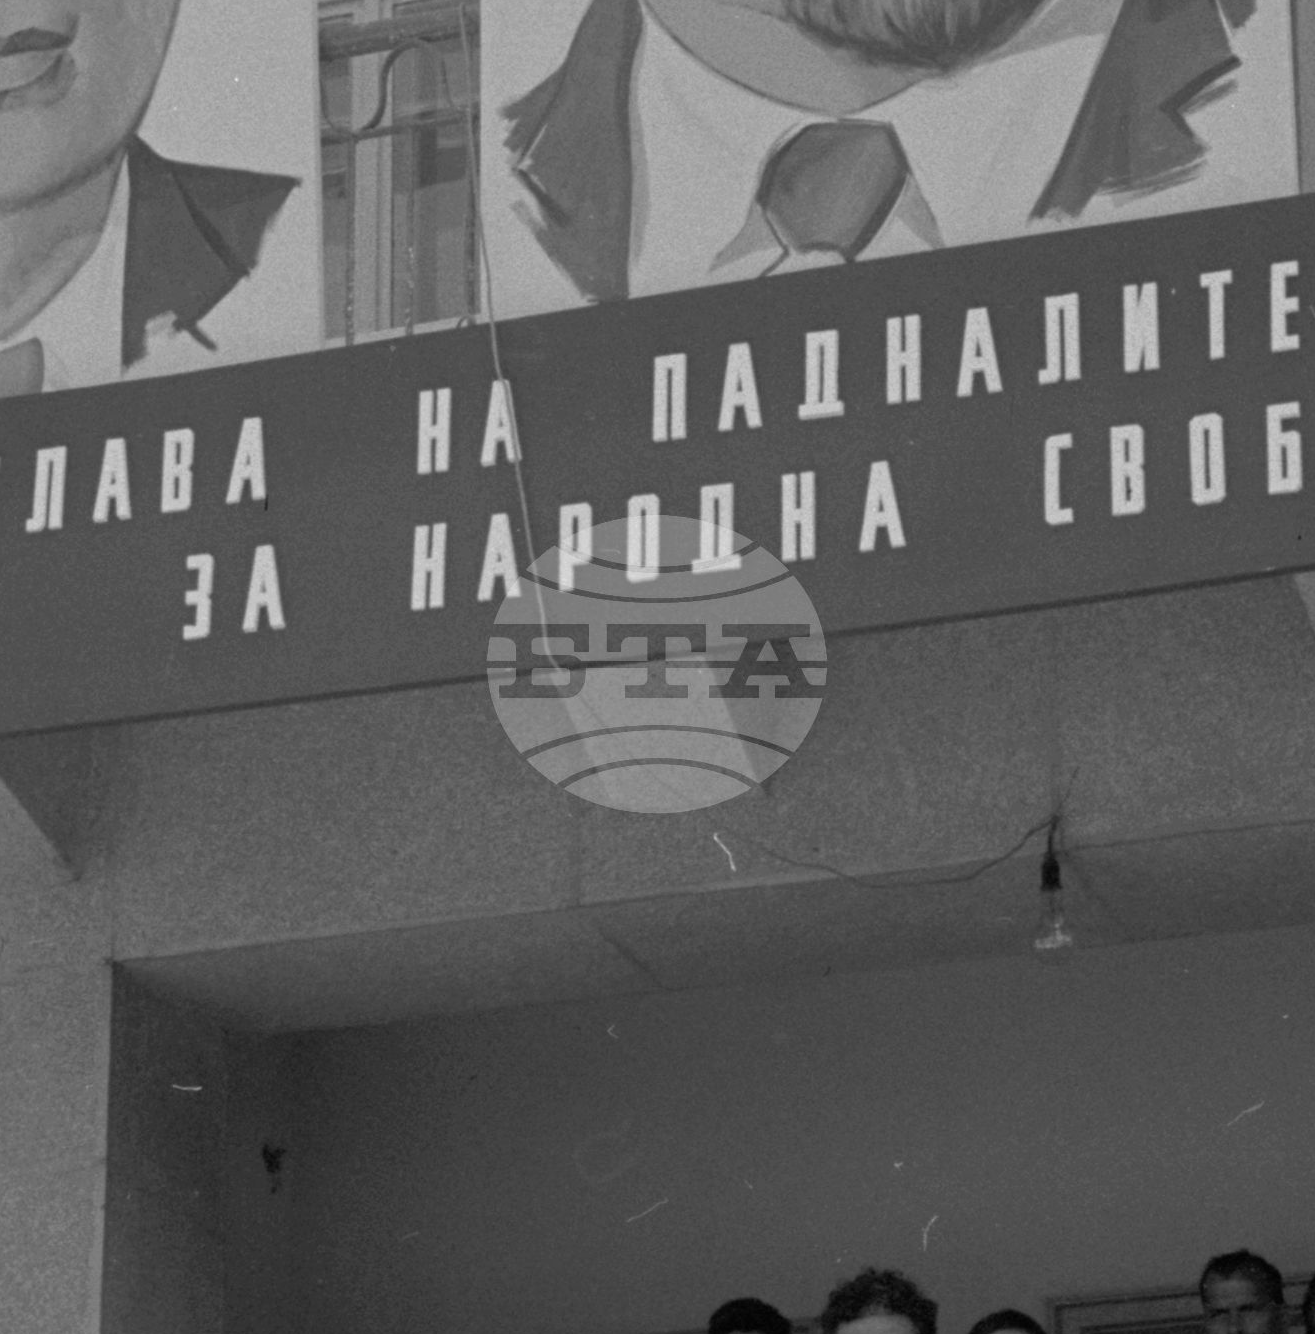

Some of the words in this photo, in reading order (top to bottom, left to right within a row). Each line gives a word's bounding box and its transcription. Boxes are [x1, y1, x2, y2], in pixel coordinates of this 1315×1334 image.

[416, 378, 523, 474] НА
[651, 259, 1301, 443] ПАДНАЛИТЕ
[182, 543, 286, 641] ЗА
[409, 460, 907, 612] НАРОДНА
